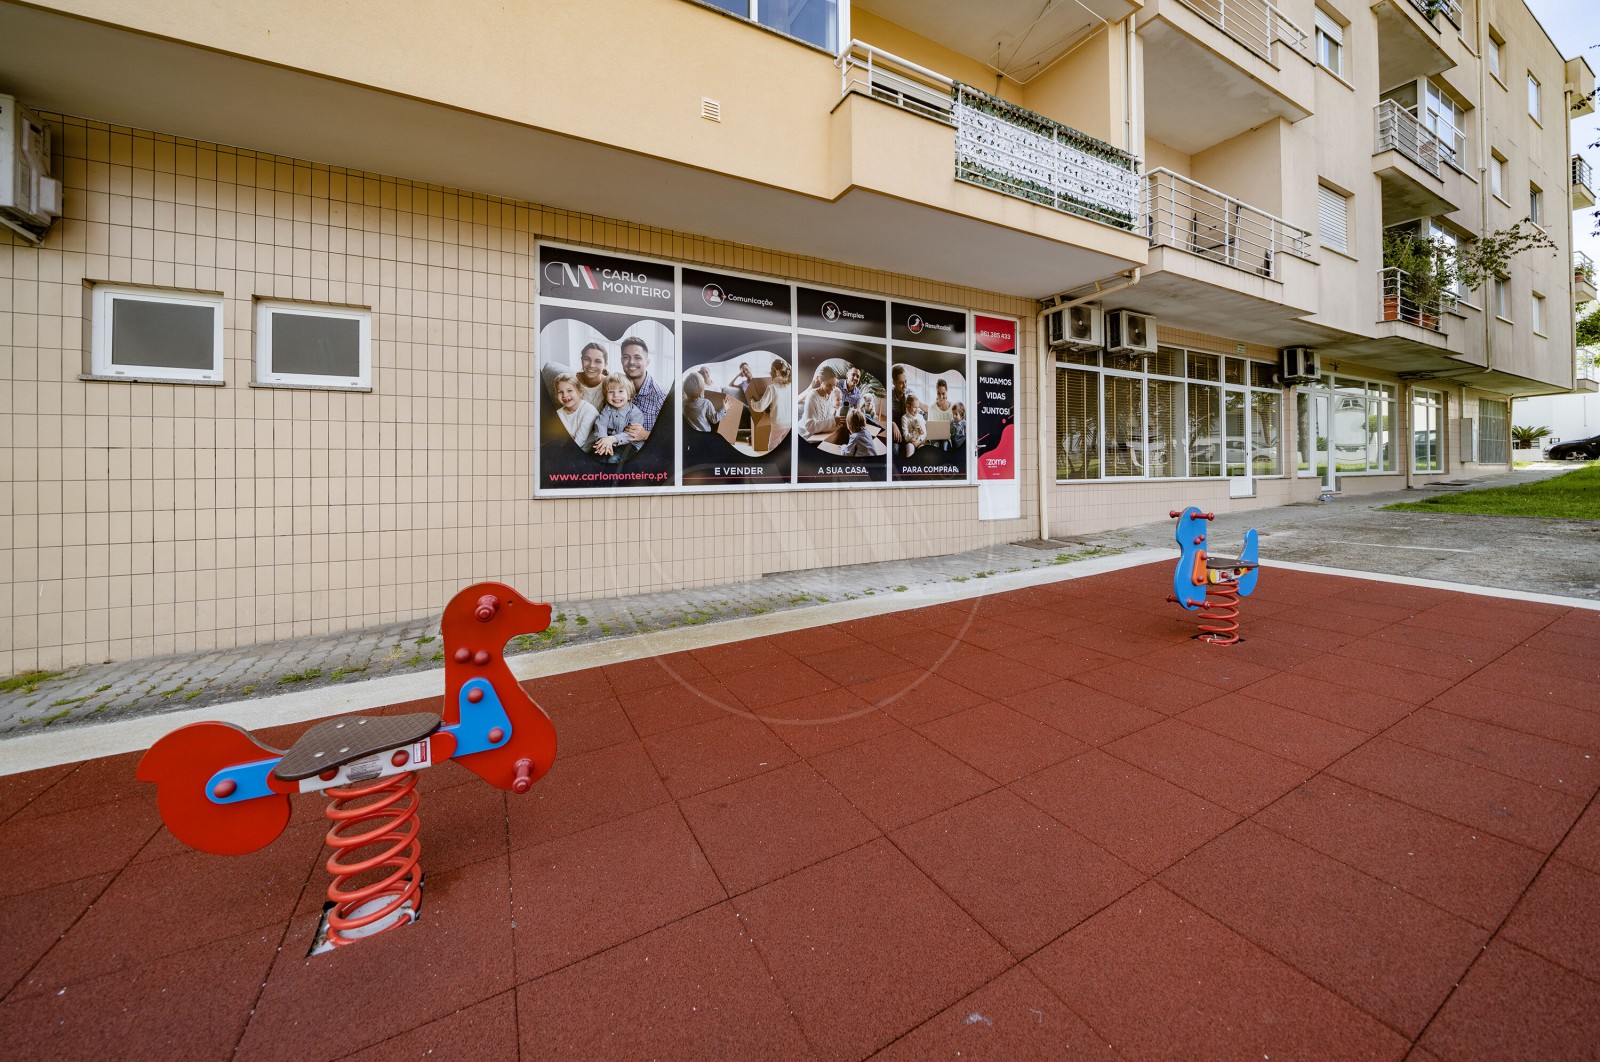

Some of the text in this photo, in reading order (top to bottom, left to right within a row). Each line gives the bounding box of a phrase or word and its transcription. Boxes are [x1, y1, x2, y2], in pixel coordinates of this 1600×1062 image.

[602, 268, 648, 284] CARLO
[602, 281, 671, 299] MONTEIRO
[727, 293, 774, 307] Comunicação
[842, 309, 865, 320] Simples
[924, 322, 952, 332] Resultados
[979, 376, 1012, 386] MUDAMOS
[985, 391, 1006, 401] VIDAS
[981, 406, 1011, 416] JUNTOS!
[714, 466, 764, 476] E VENDER
[817, 466, 869, 475] A SUA CASA.
[902, 466, 923, 474] PARA
[549, 471, 668, 482] www.carlomonteiro.pt
